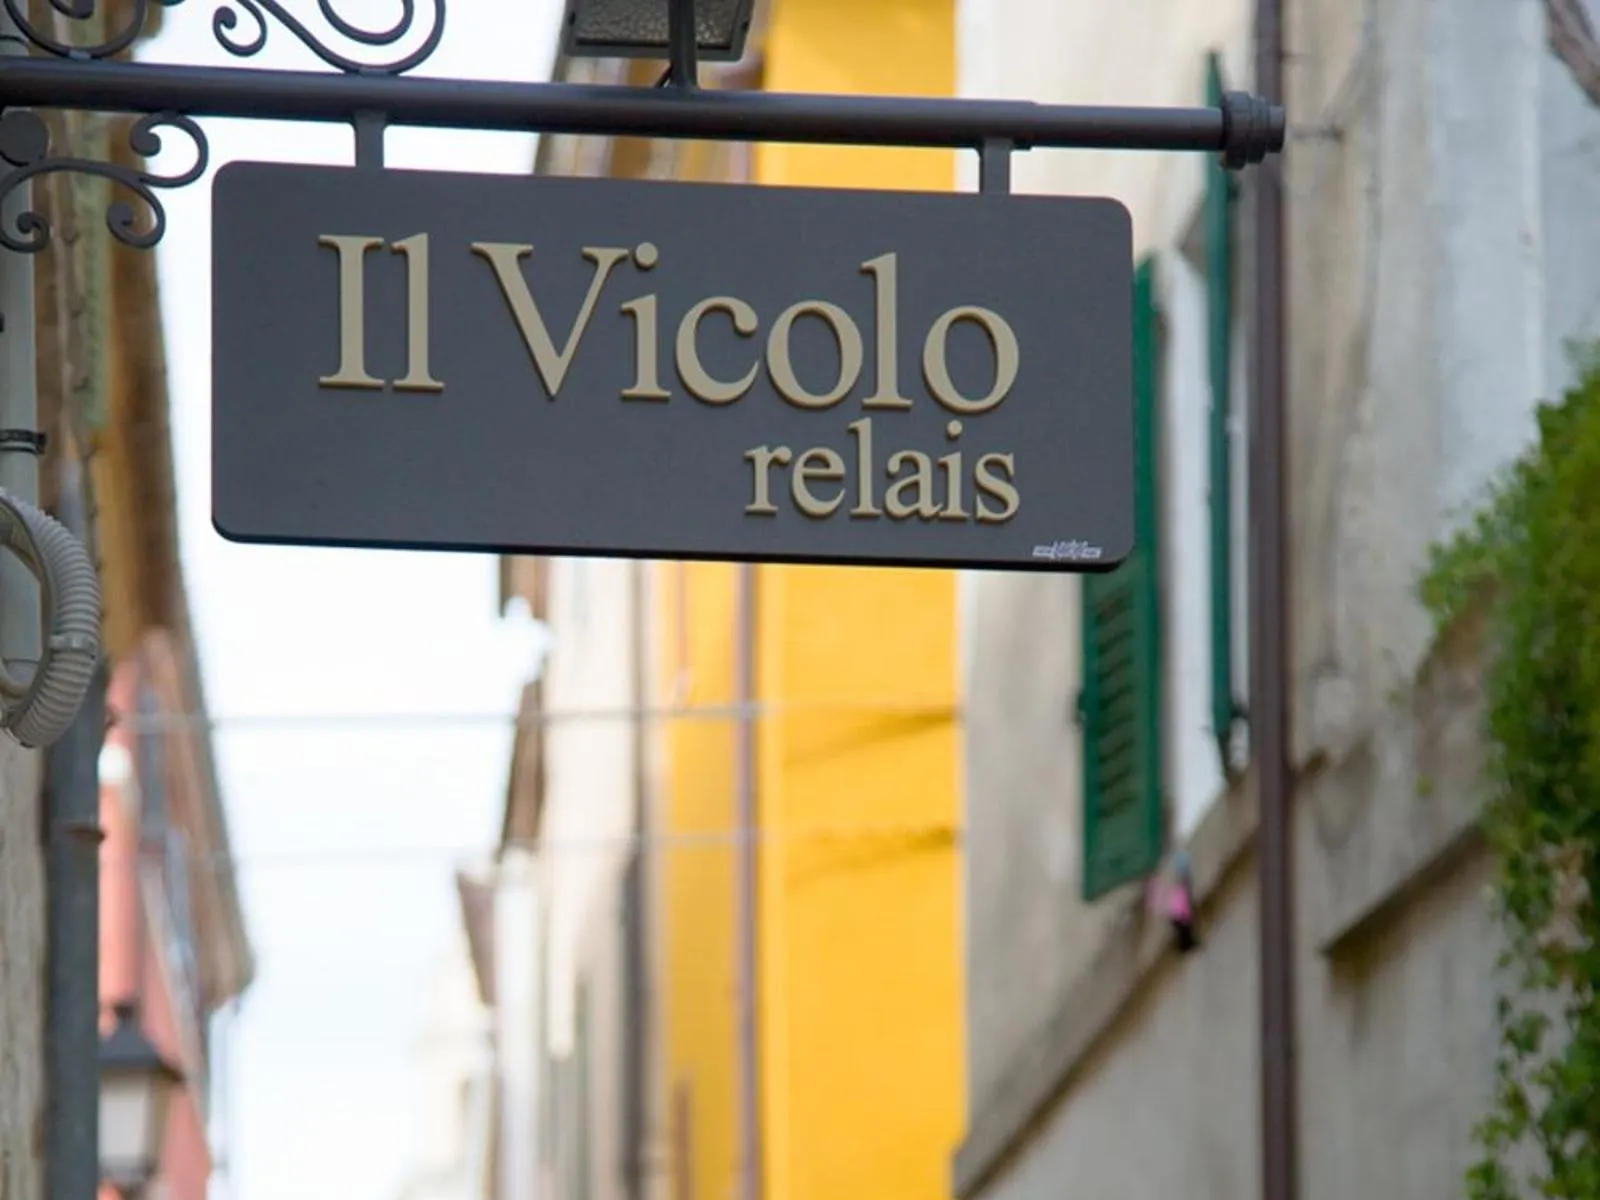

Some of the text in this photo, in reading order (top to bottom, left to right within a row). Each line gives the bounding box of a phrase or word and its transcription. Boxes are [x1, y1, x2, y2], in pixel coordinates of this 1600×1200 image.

[317, 232, 1020, 414] Il Vicolo
[744, 416, 1020, 523] relais
